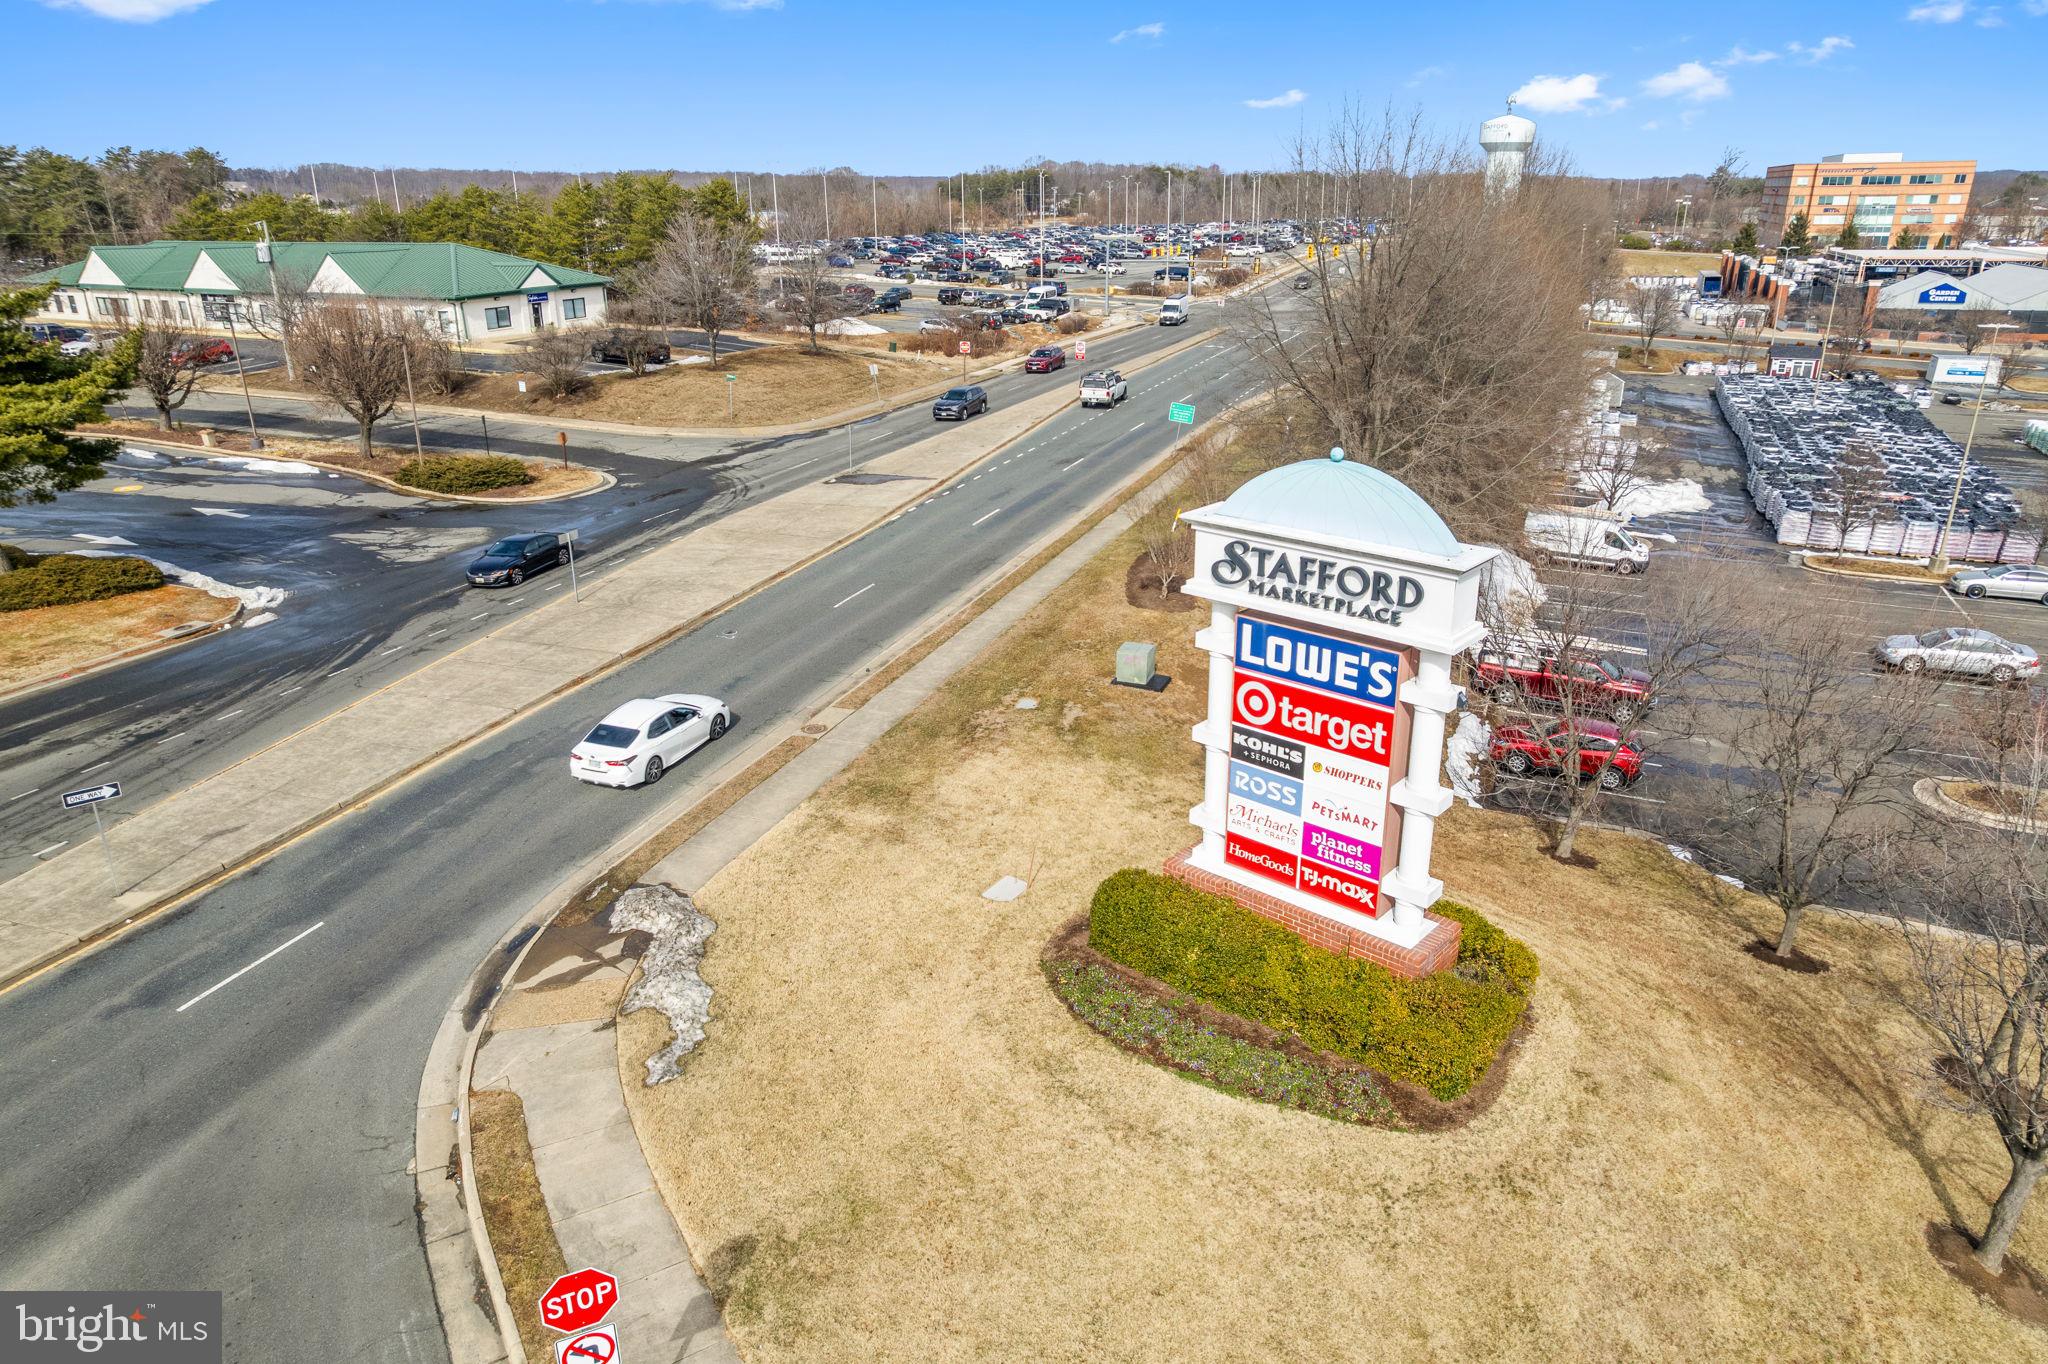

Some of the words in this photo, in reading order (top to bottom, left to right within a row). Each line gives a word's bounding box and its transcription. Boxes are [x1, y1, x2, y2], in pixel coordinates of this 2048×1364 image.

[1211, 540, 1425, 608] STAFFORD
[1248, 579, 1402, 626] MARKETPLACE
[1241, 623, 1393, 698] LOWE'S
[1279, 696, 1387, 754] target
[1233, 732, 1303, 763] KOHL'S
[1250, 752, 1291, 771] SEPHORA
[1235, 770, 1297, 806] ROSS
[1324, 766, 1383, 790] SHOPPERS
[69, 794, 84, 803] ONE
[87, 790, 103, 799] WAY
[1230, 805, 1298, 837] Michaels
[1232, 818, 1251, 829] ARTS
[1264, 829, 1296, 846] CRAFTS
[1228, 842, 1294, 876] HomeGoods
[1311, 831, 1363, 858] planet
[1316, 844, 1372, 874] fitness
[546, 1281, 612, 1319] STOP
